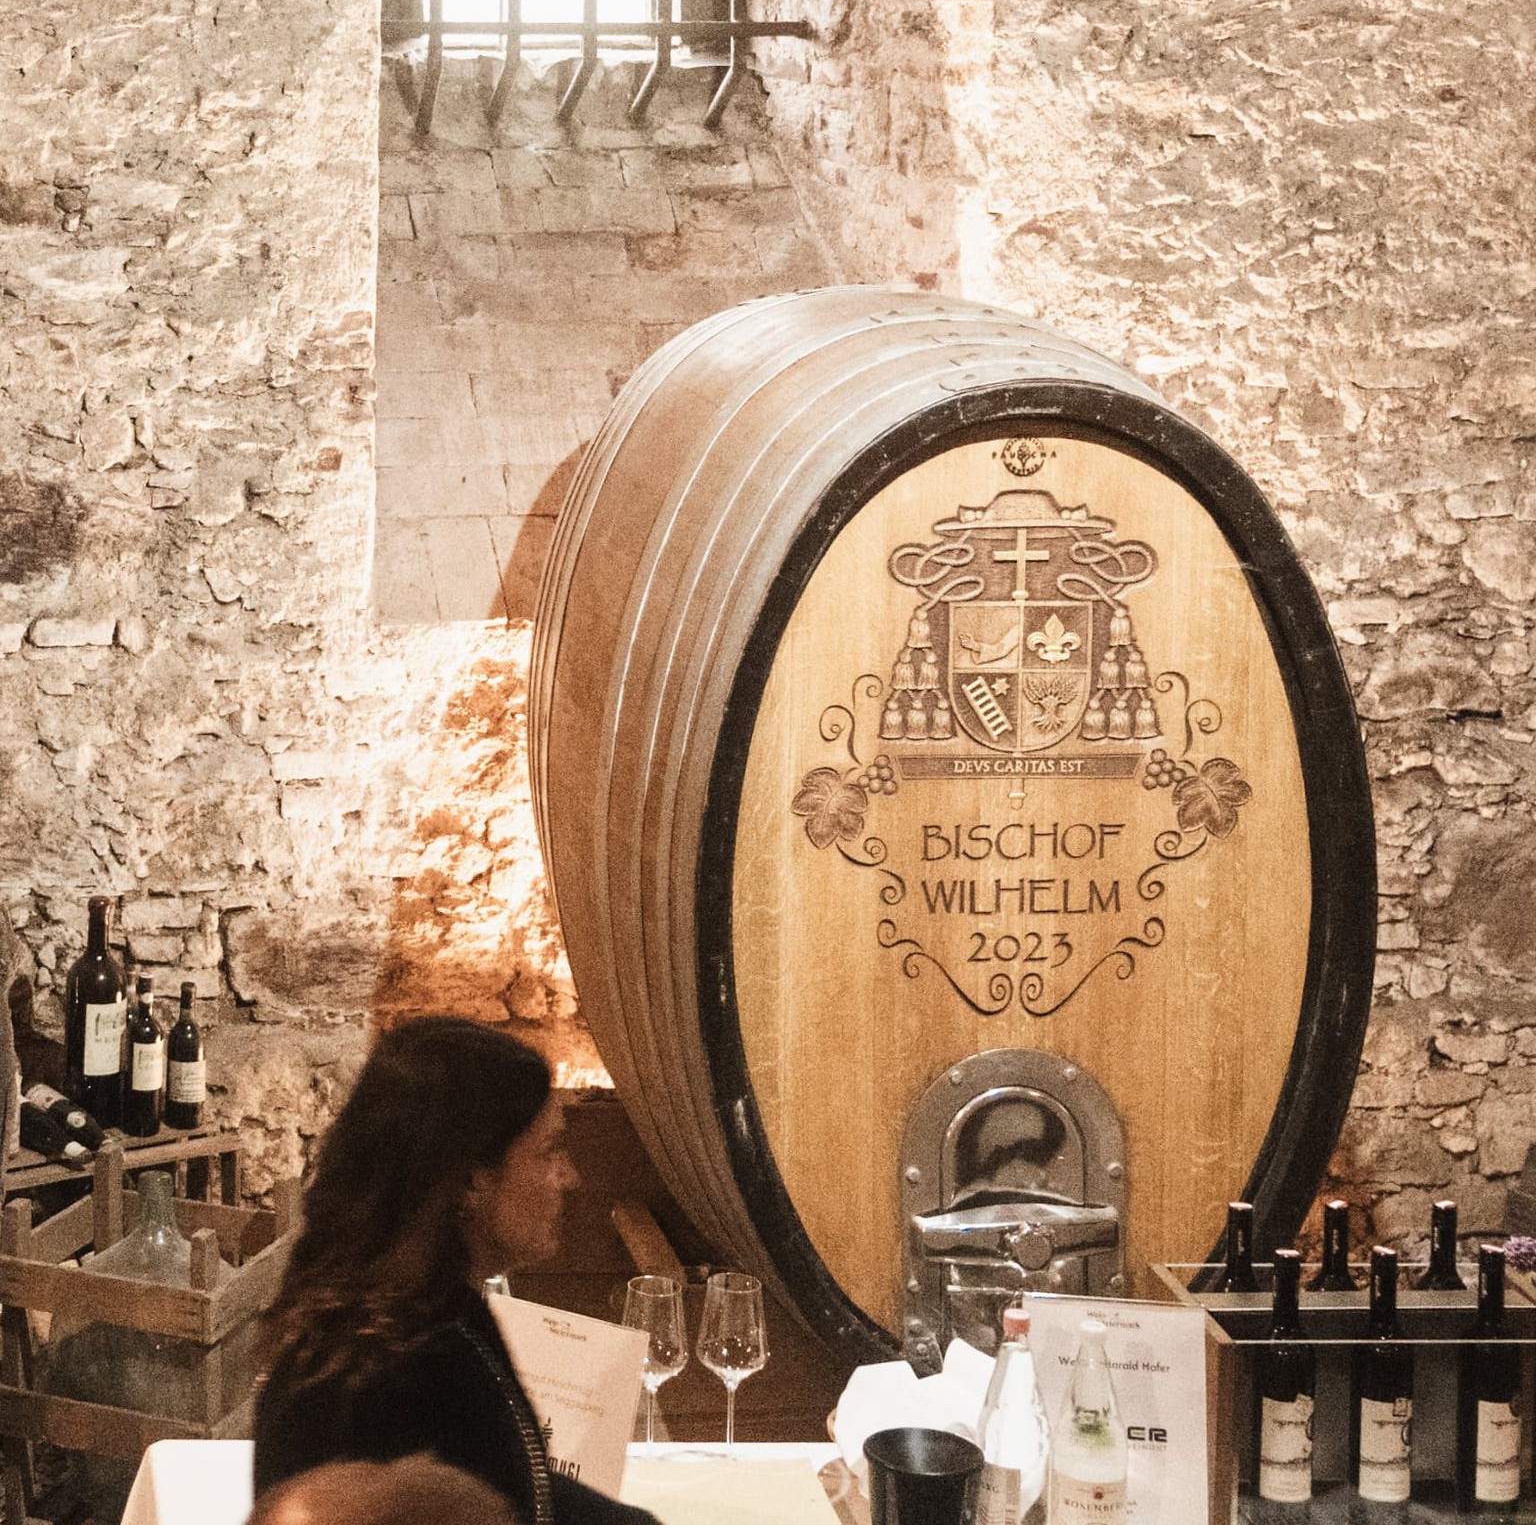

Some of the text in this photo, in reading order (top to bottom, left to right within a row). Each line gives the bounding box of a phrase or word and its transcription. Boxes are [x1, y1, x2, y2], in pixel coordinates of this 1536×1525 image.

[953, 757, 1085, 775] DEVS CARITAS EST
[921, 823, 1126, 862] BISCHOF
[921, 878, 1123, 915] WILHELM
[968, 931, 1074, 969] 2023
[1102, 1319, 1141, 1329] eiermark
[1142, 1361, 1171, 1373] Hofer
[1064, 1498, 1121, 1512] ROSENBER
